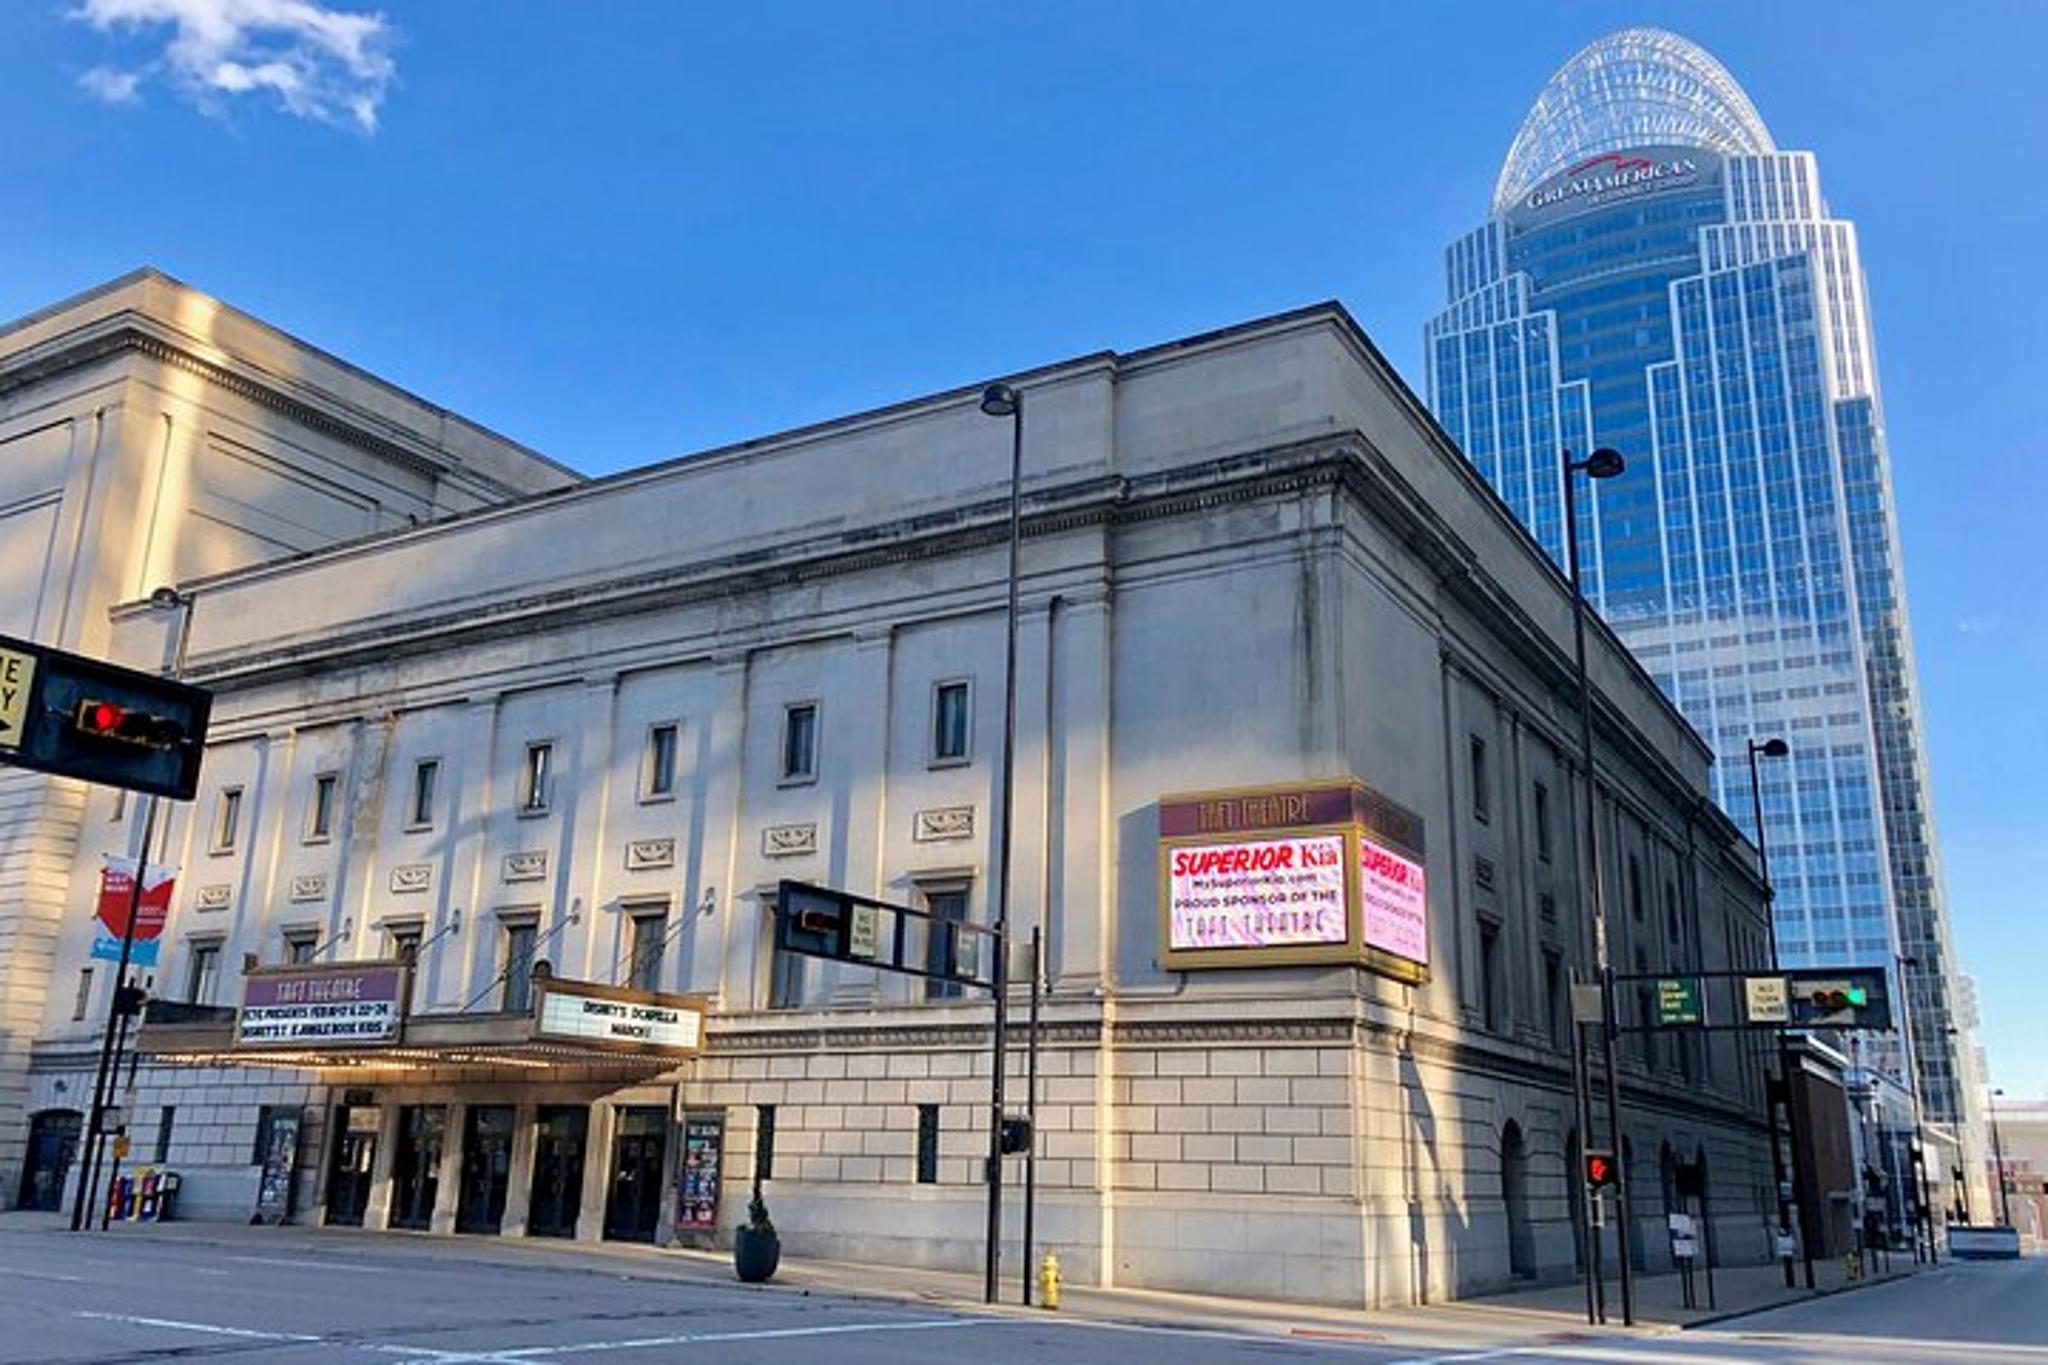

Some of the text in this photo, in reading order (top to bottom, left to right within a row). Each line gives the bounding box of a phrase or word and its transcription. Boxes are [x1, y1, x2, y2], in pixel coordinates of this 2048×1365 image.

[1174, 844, 1338, 877] SUPERIOR Kia
[1175, 890, 1338, 909] PROUD SPONSOR OF THE
[1186, 909, 1326, 937] TAFT THEATRE
